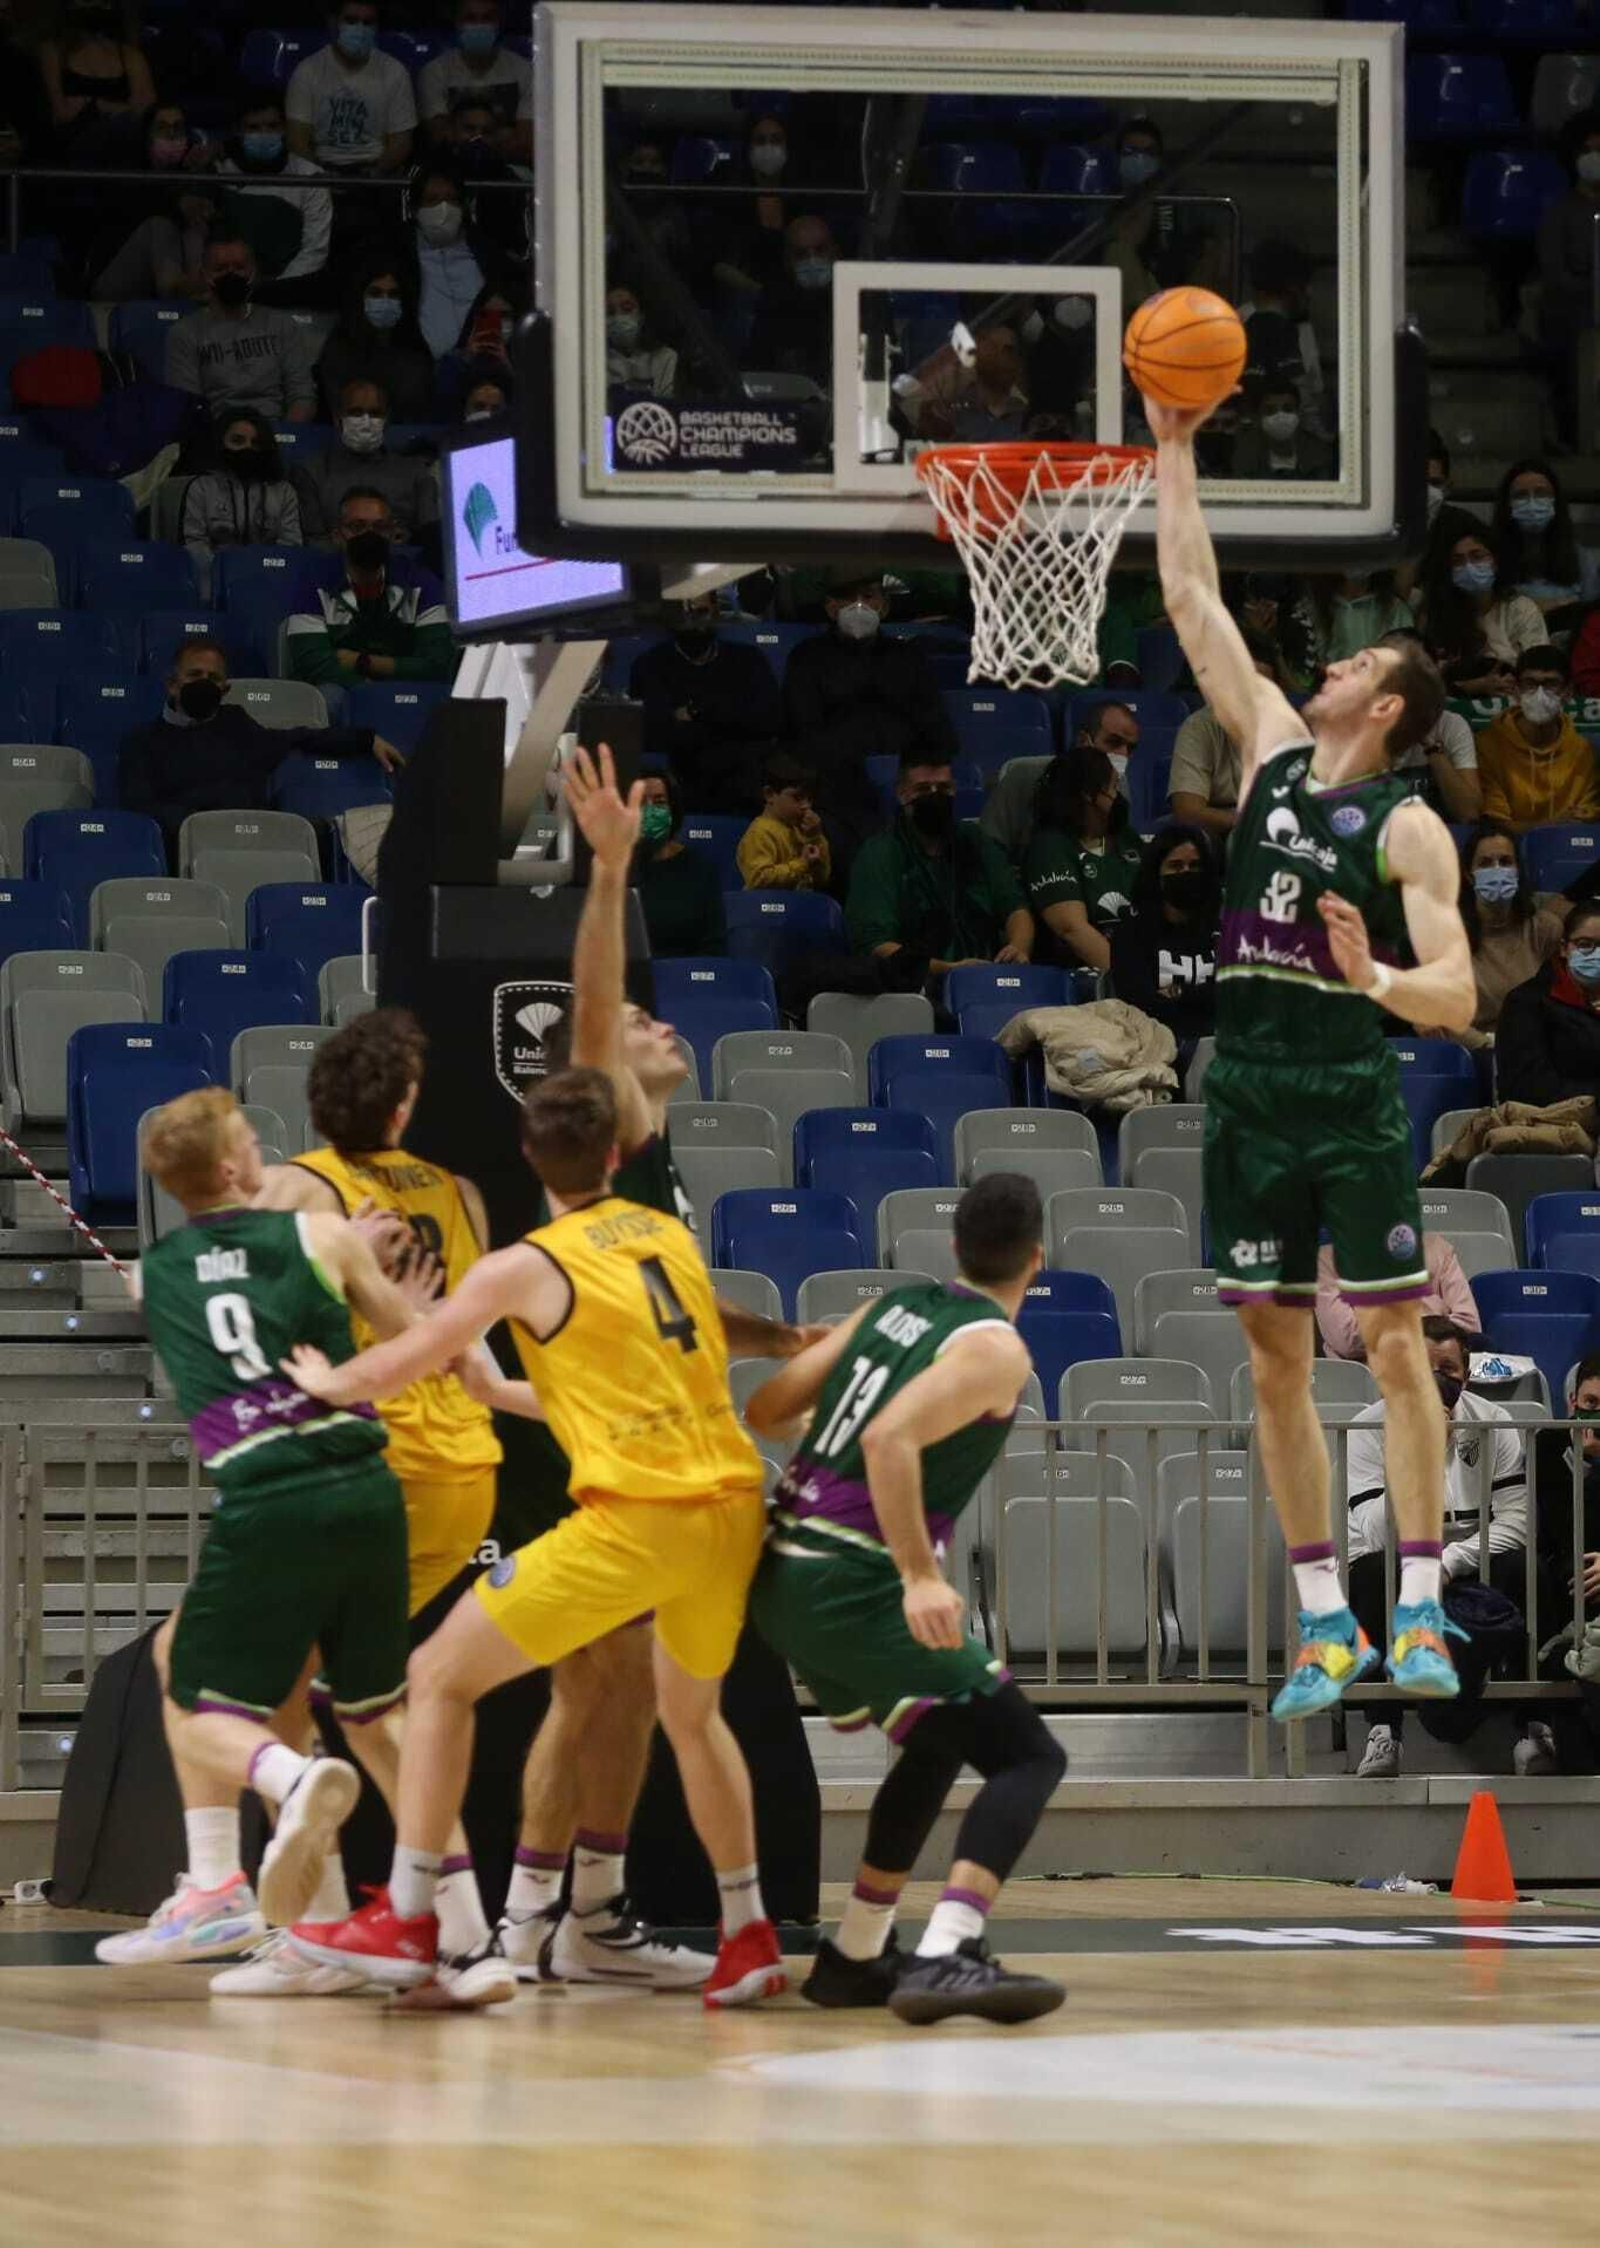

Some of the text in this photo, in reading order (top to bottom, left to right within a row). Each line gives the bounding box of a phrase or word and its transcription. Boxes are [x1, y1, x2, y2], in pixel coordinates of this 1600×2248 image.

[679, 411, 782, 426] BASKETBALL
[679, 426, 797, 444] CHAMPIONS
[679, 443, 744, 459] LEAGUE
[1259, 869, 1302, 924] 32
[637, 1254, 700, 1354] 4
[206, 1293, 275, 1382] 9
[813, 1355, 890, 1458] 13
